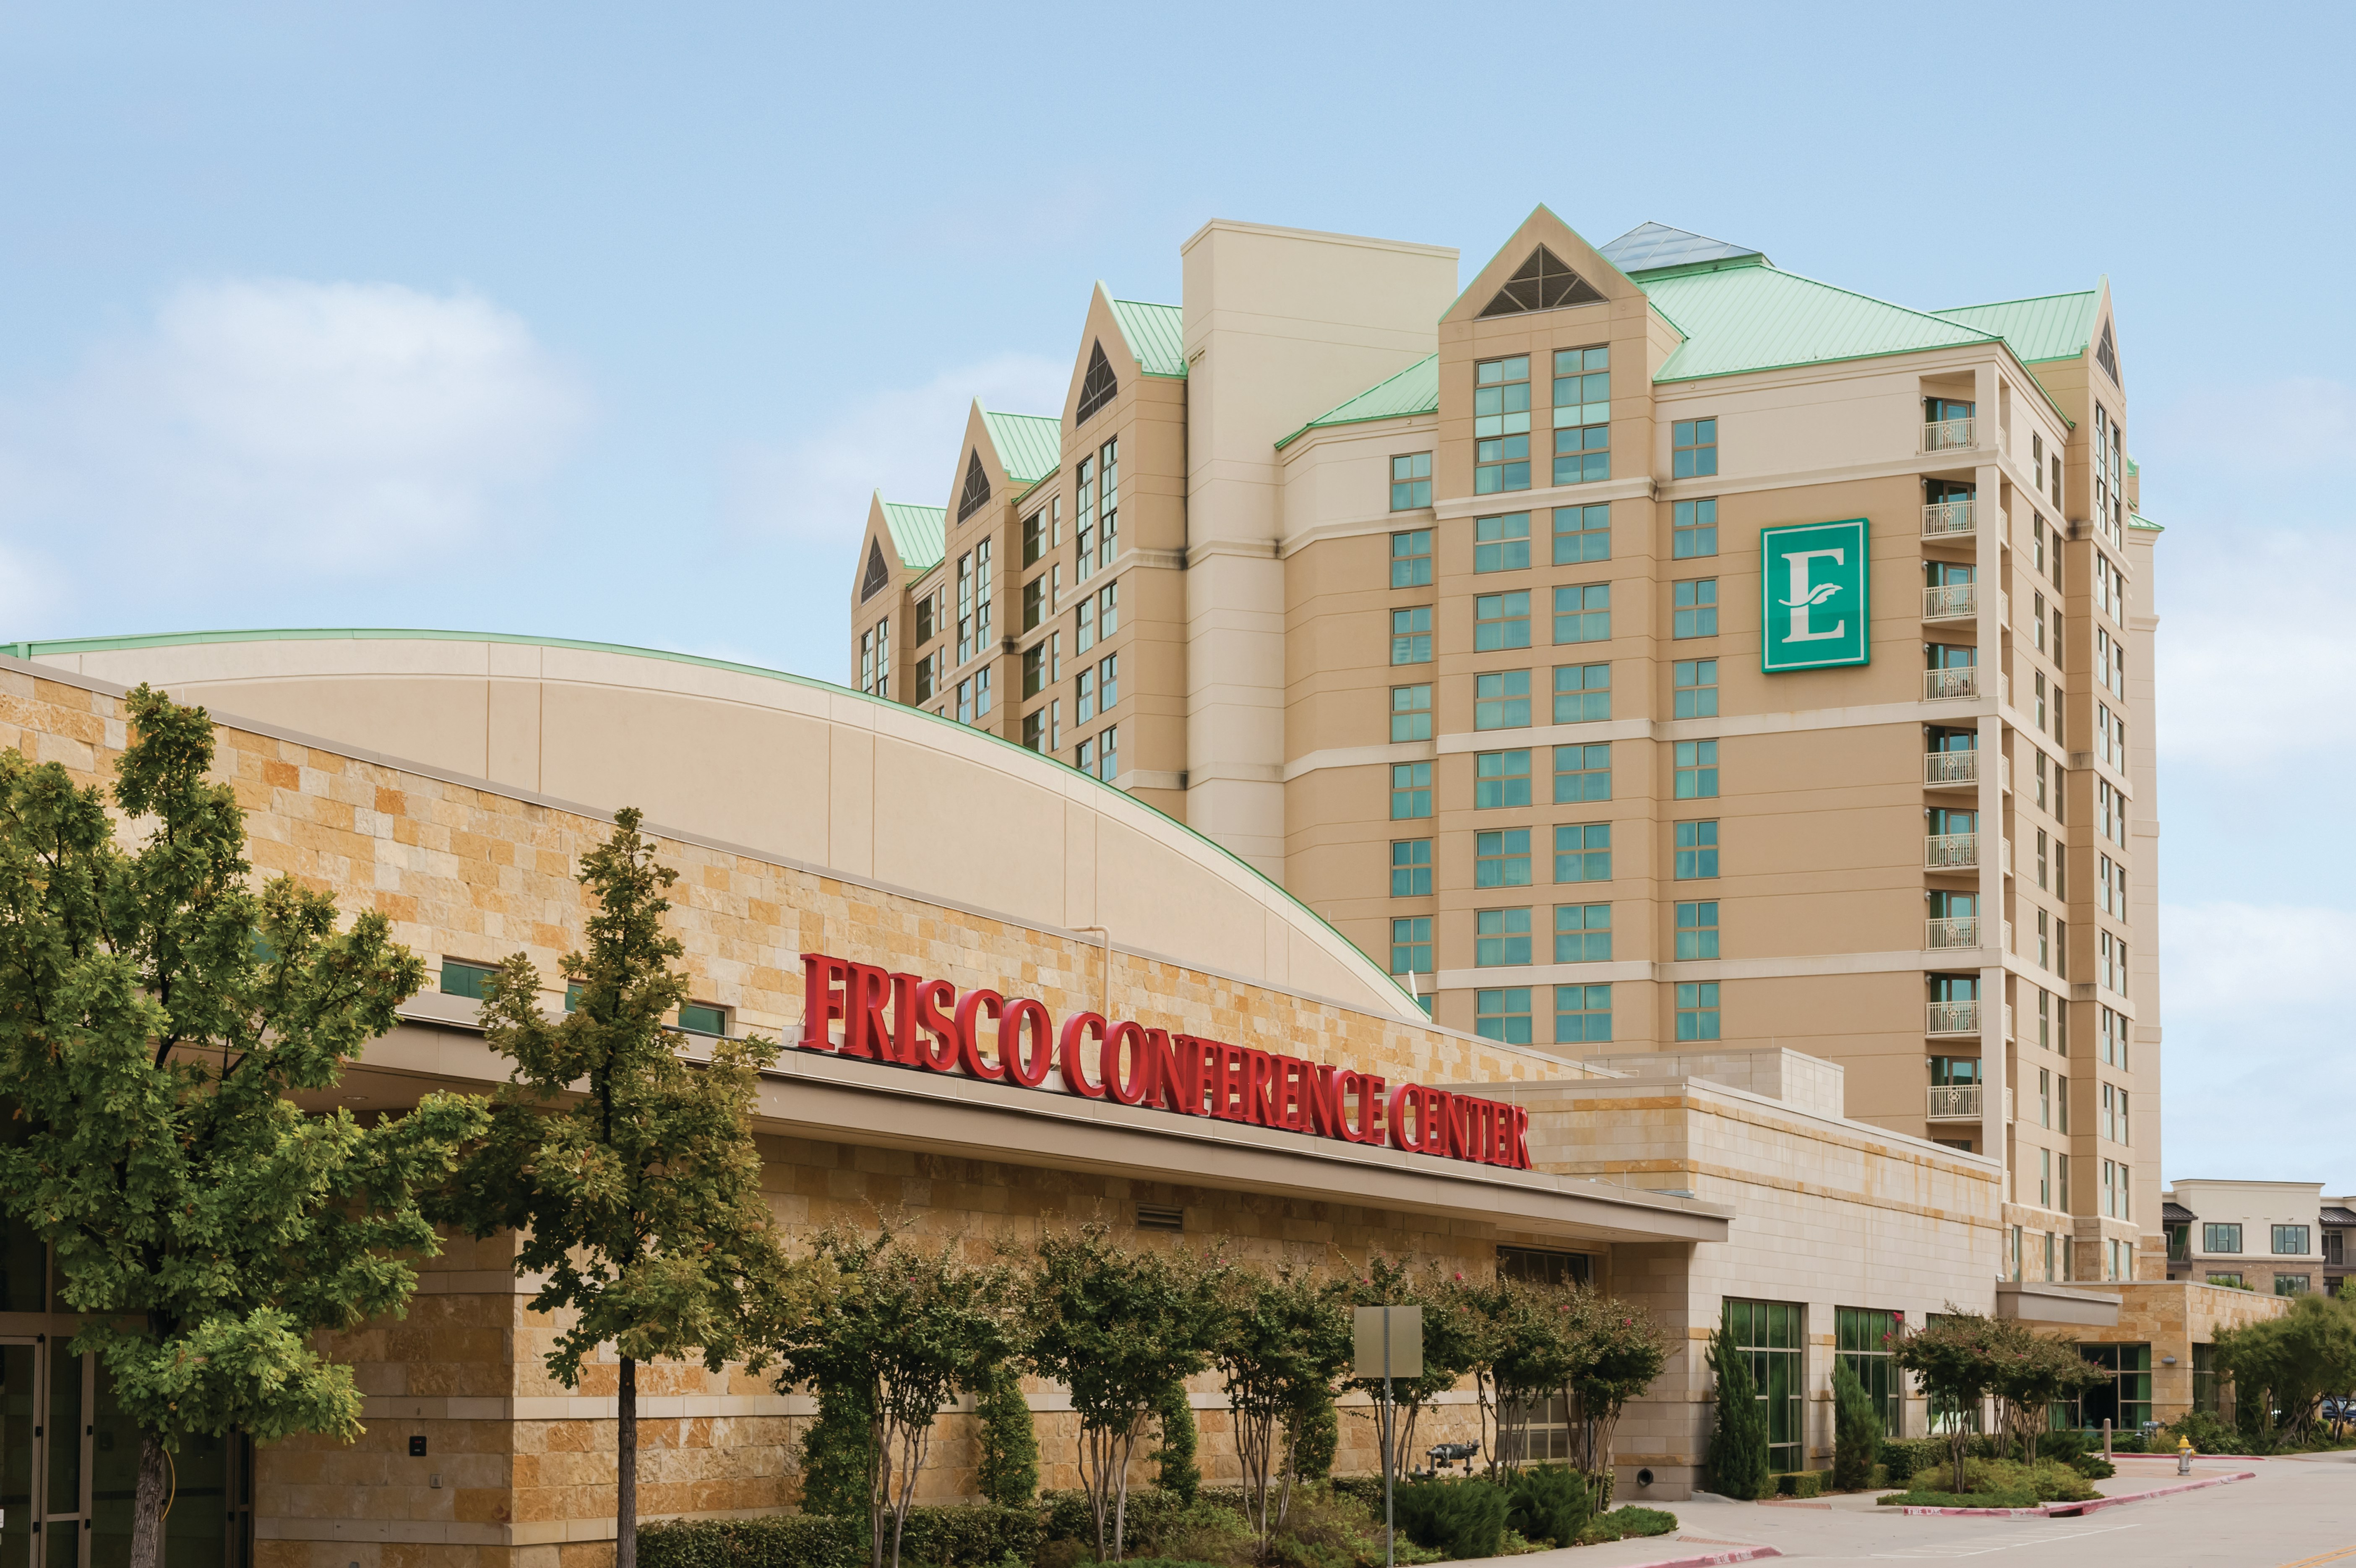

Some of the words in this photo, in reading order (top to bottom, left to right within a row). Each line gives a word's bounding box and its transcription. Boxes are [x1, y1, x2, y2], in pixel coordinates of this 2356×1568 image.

[1780, 548, 1844, 643] E
[798, 953, 1053, 1087] FRISCO
[1059, 1012, 1386, 1145] CONFERENCE
[1388, 1084, 1532, 1169] CENTER
